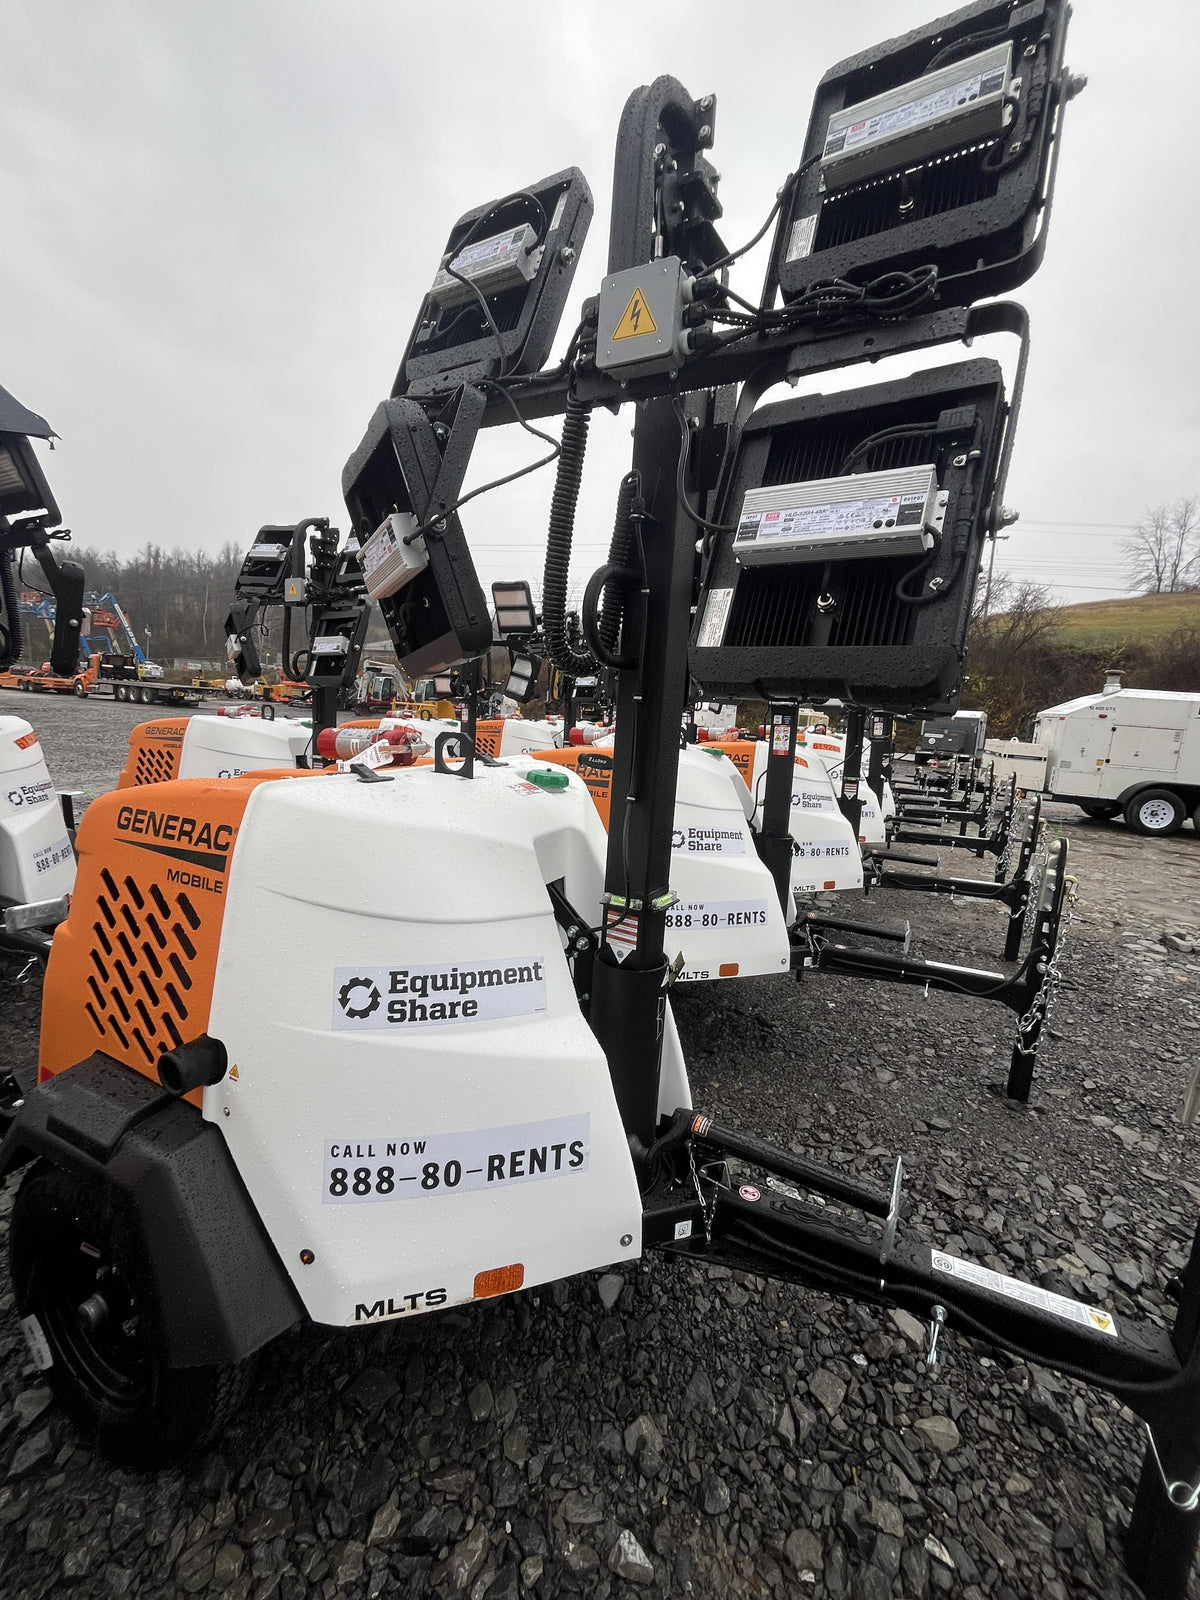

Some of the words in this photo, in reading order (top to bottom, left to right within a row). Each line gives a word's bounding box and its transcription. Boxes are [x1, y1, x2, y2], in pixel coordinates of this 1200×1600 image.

[145, 726, 186, 736] GENERAC
[26, 793, 49, 806] Share
[802, 801, 823, 810] Share
[116, 806, 233, 851] GENERAC
[687, 827, 744, 842] Equipment
[687, 840, 723, 852] Share
[166, 868, 224, 894] MOBILE
[793, 884, 816, 892] MLTS
[666, 910, 766, 928] 888-80-RENTS
[388, 961, 543, 998] Equipment
[676, 970, 710, 980] MLTS
[387, 998, 478, 1024] Share
[330, 1143, 376, 1159] CALL
[386, 1140, 427, 1157] NOW
[329, 1140, 585, 1197] 888-80-RENTS
[354, 1286, 448, 1321] MLTS
